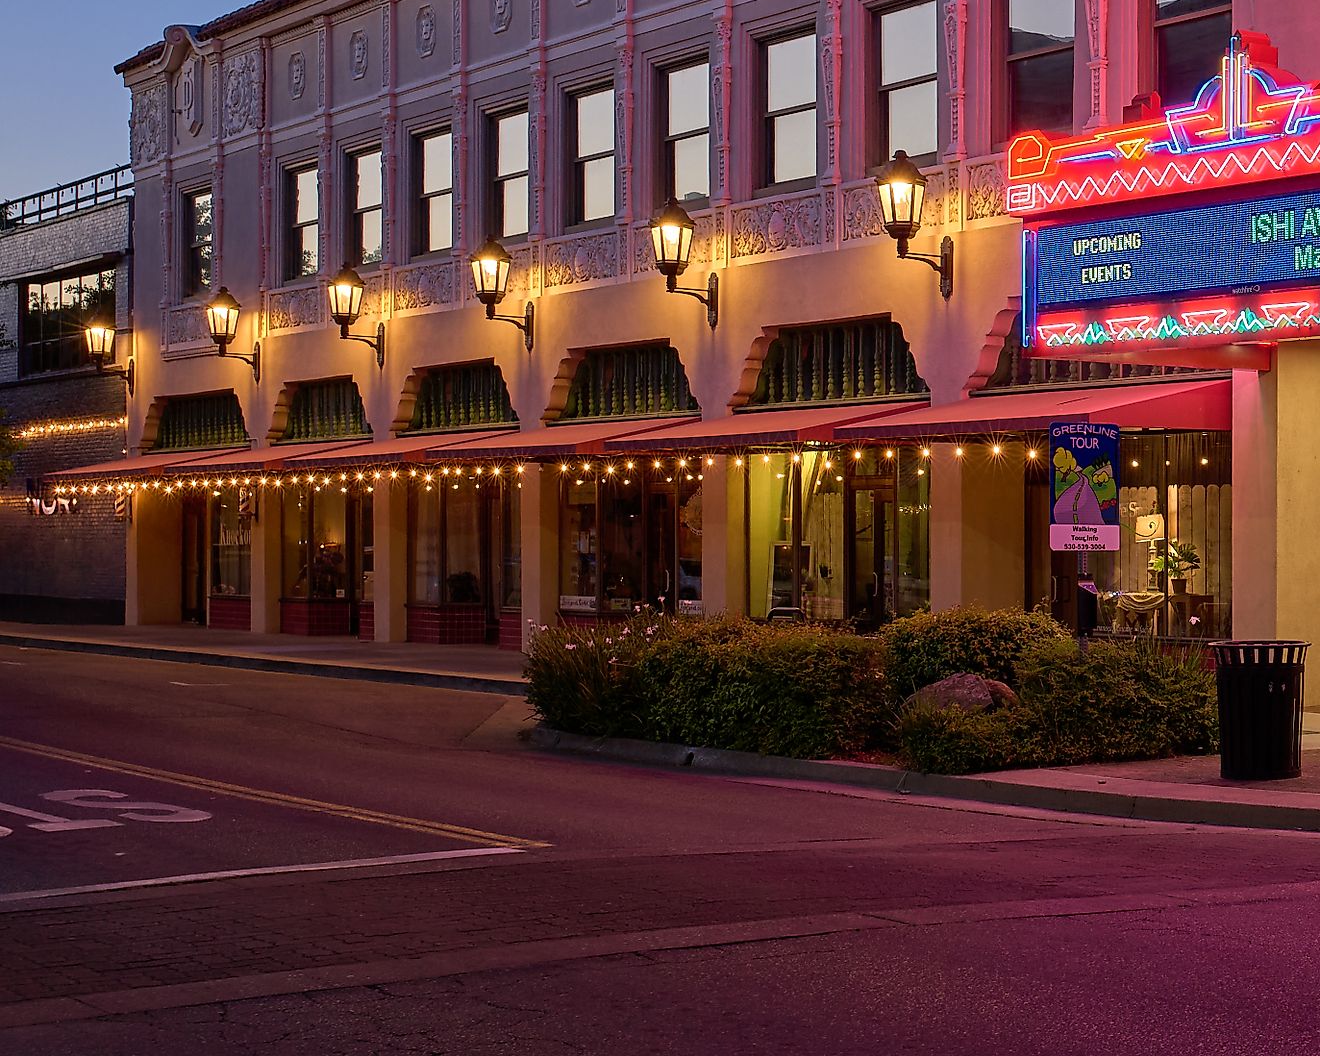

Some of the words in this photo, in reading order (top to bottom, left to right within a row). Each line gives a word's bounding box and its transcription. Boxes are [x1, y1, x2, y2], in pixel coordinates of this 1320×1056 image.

[1250, 210, 1296, 244] ISHI
[1072, 231, 1142, 258] UPCOMING
[1081, 261, 1133, 286] EVENTS
[1052, 424, 1119, 440] GREENLINE
[1070, 436, 1100, 450] TOUR
[1072, 525, 1098, 533] Walking
[0, 789, 213, 838] ST
